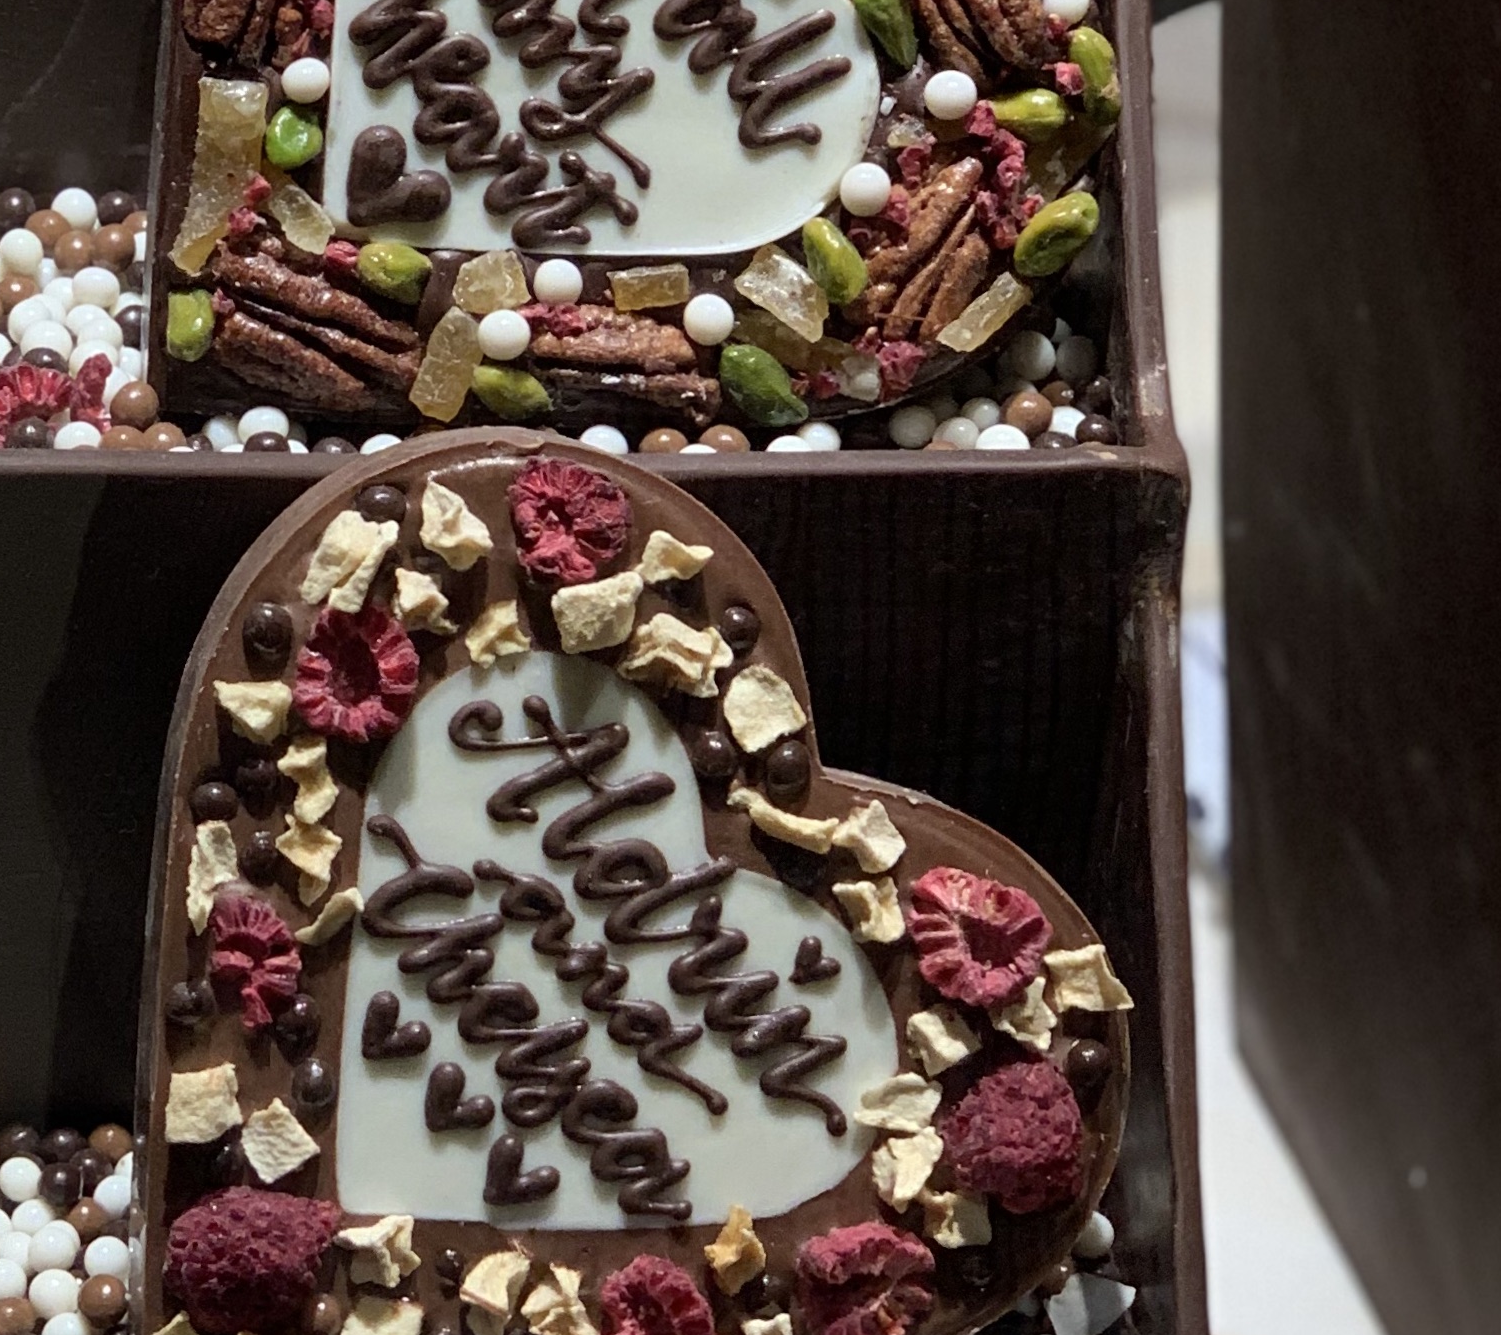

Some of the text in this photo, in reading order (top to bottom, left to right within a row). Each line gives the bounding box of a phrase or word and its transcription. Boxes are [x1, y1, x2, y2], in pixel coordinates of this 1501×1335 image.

[361, 814, 692, 1220] Chelsea
[448, 694, 848, 1136] Aldrin
[472, 858, 729, 1116] and
